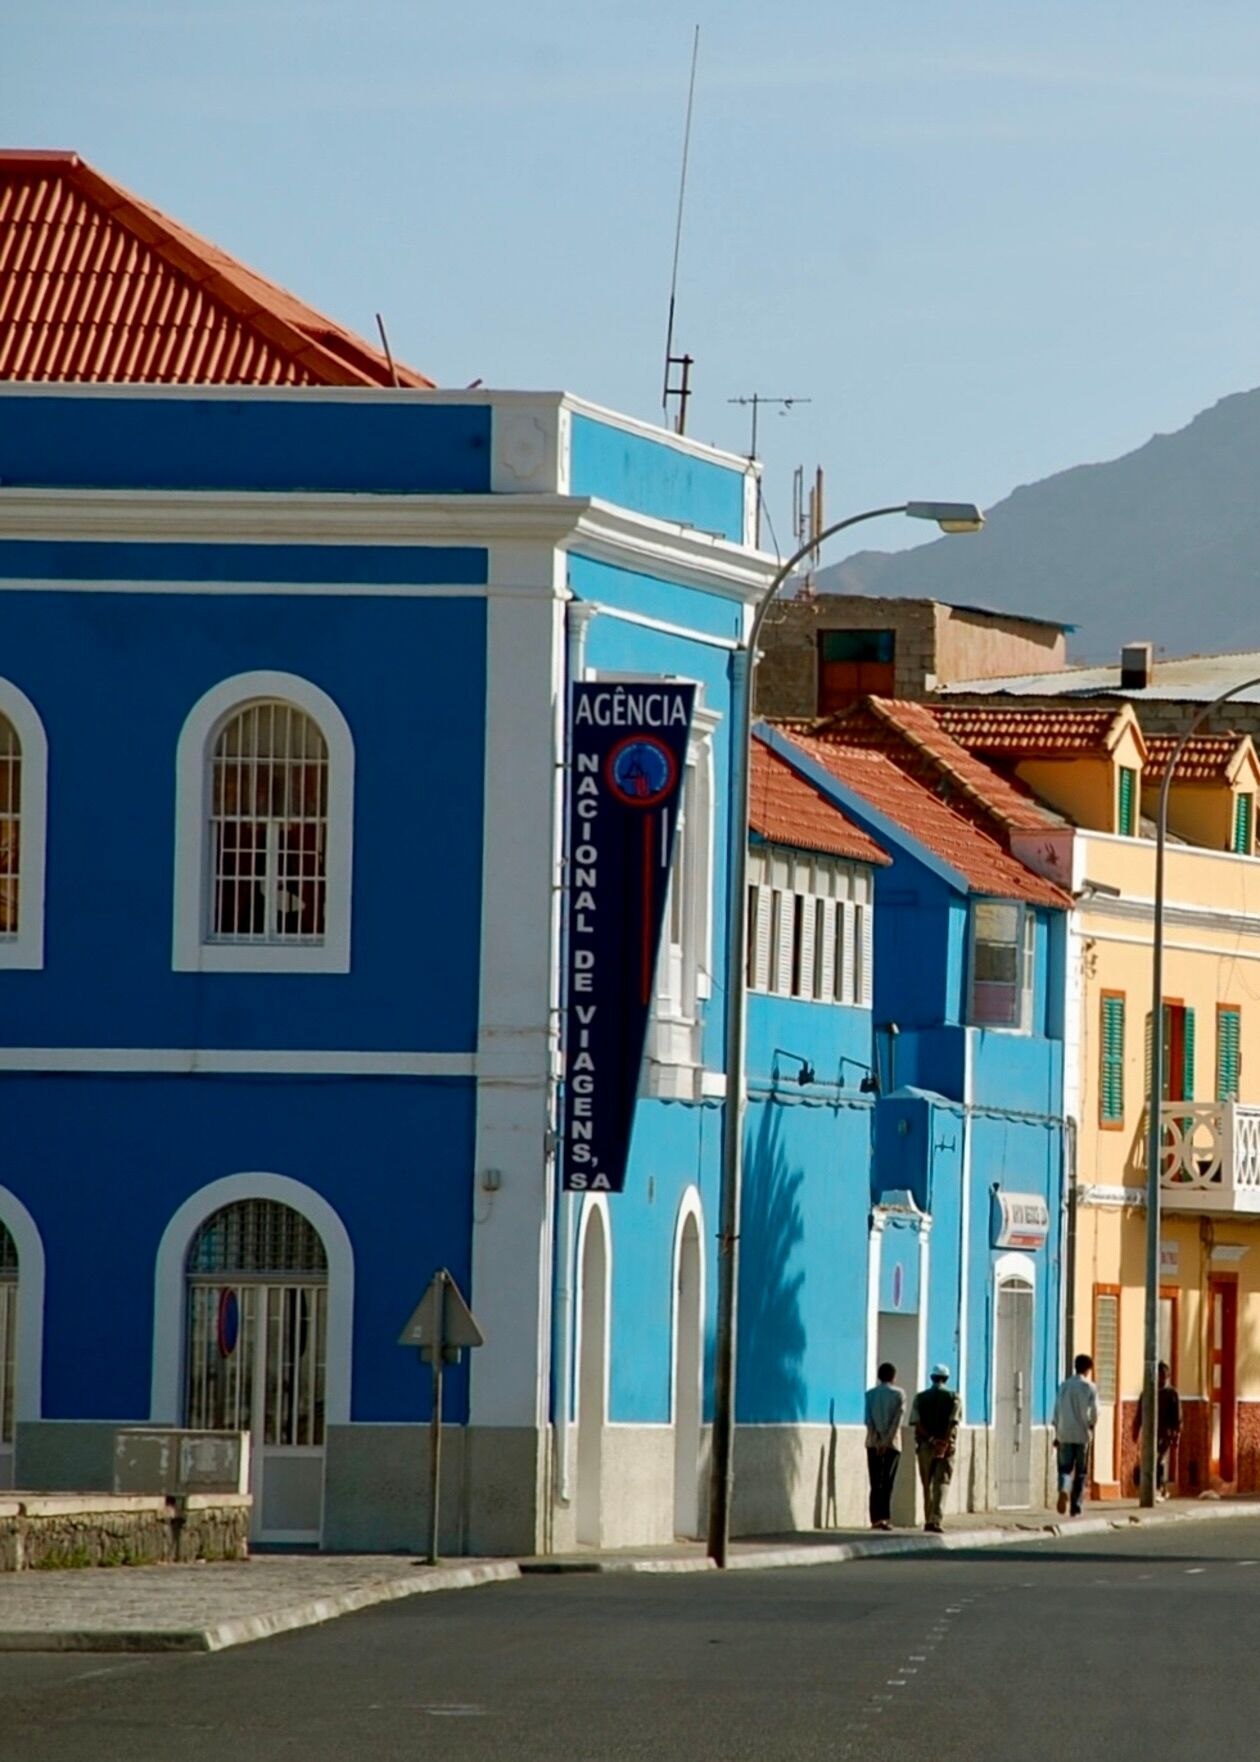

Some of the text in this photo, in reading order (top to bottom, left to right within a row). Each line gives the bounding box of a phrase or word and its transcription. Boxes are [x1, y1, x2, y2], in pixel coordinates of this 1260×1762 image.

[575, 685, 688, 727] AGÊNCIA
[571, 753, 599, 1168] NACIONAL DE VIAGENS,
